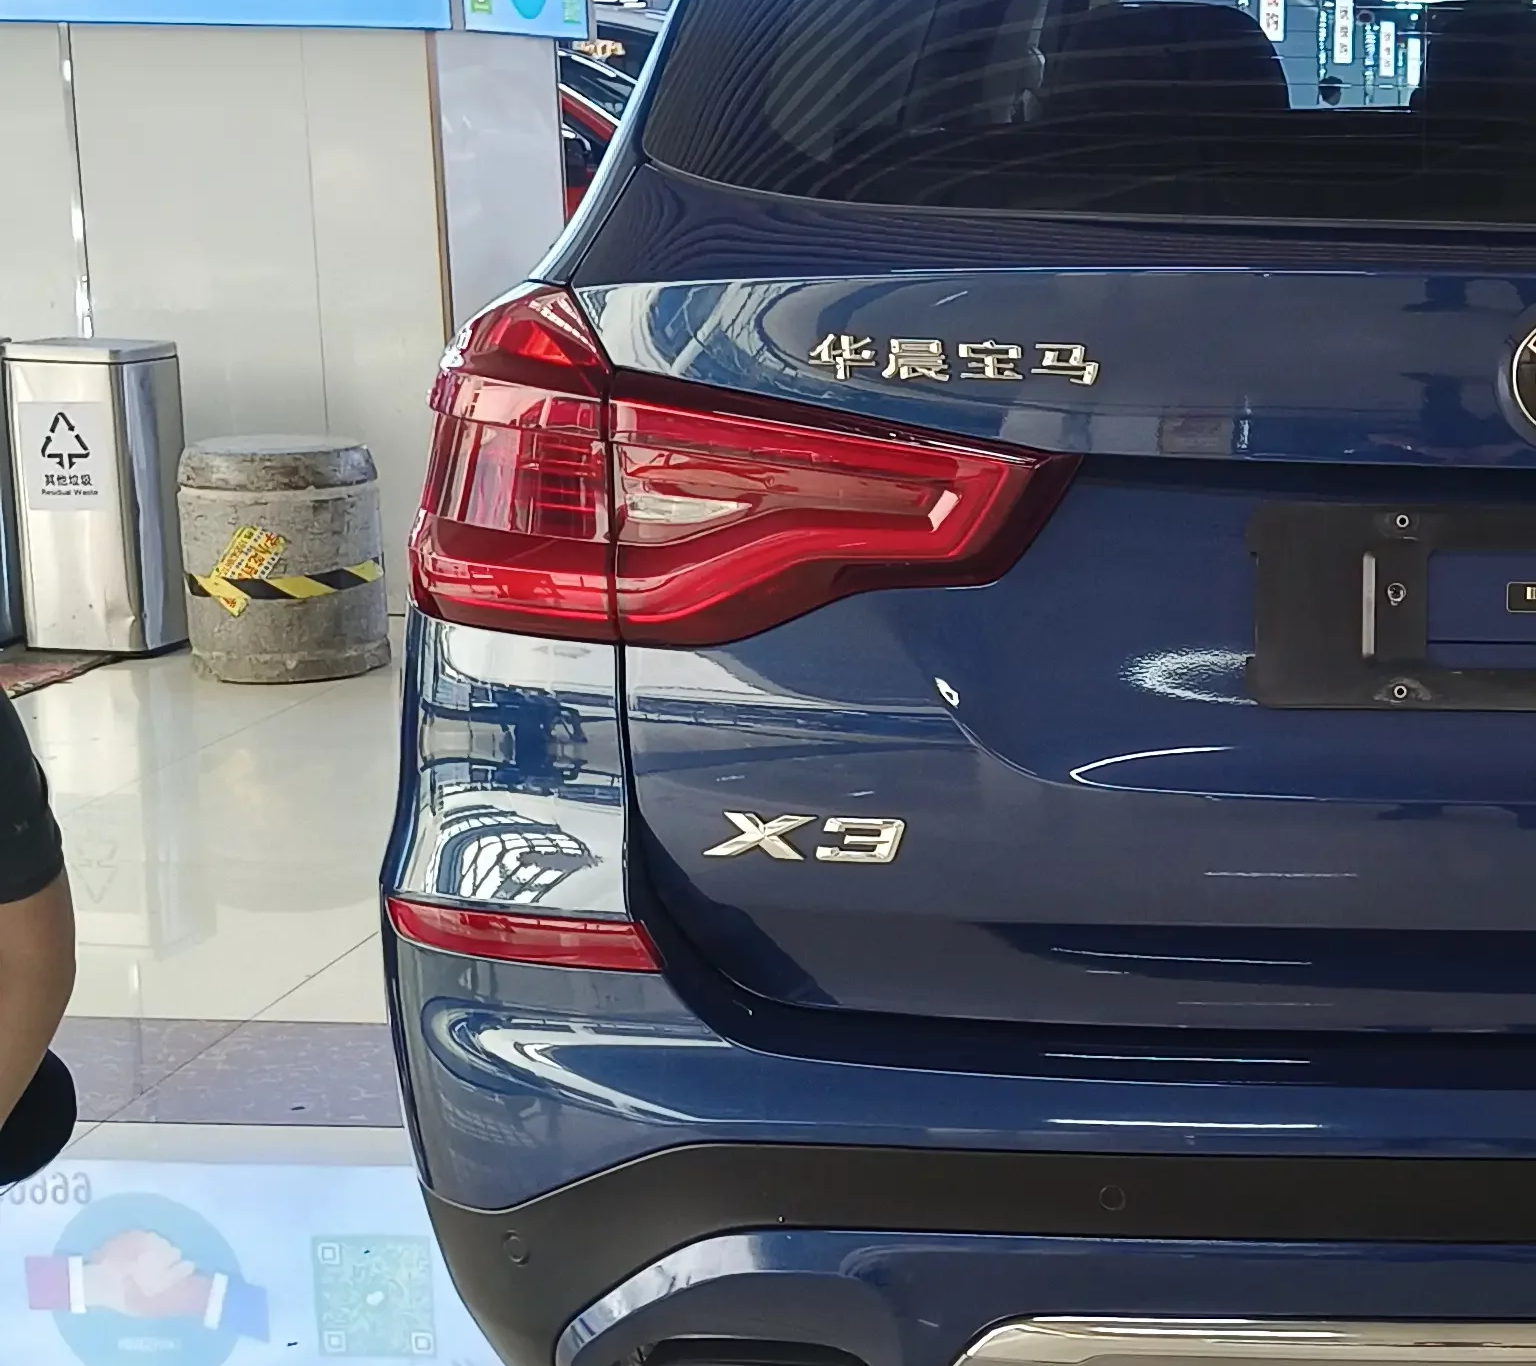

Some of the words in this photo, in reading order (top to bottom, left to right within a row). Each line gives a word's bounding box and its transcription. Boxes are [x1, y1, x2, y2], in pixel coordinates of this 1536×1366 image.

[808, 333, 1100, 386] 华晨宝马
[702, 811, 906, 864] X3
